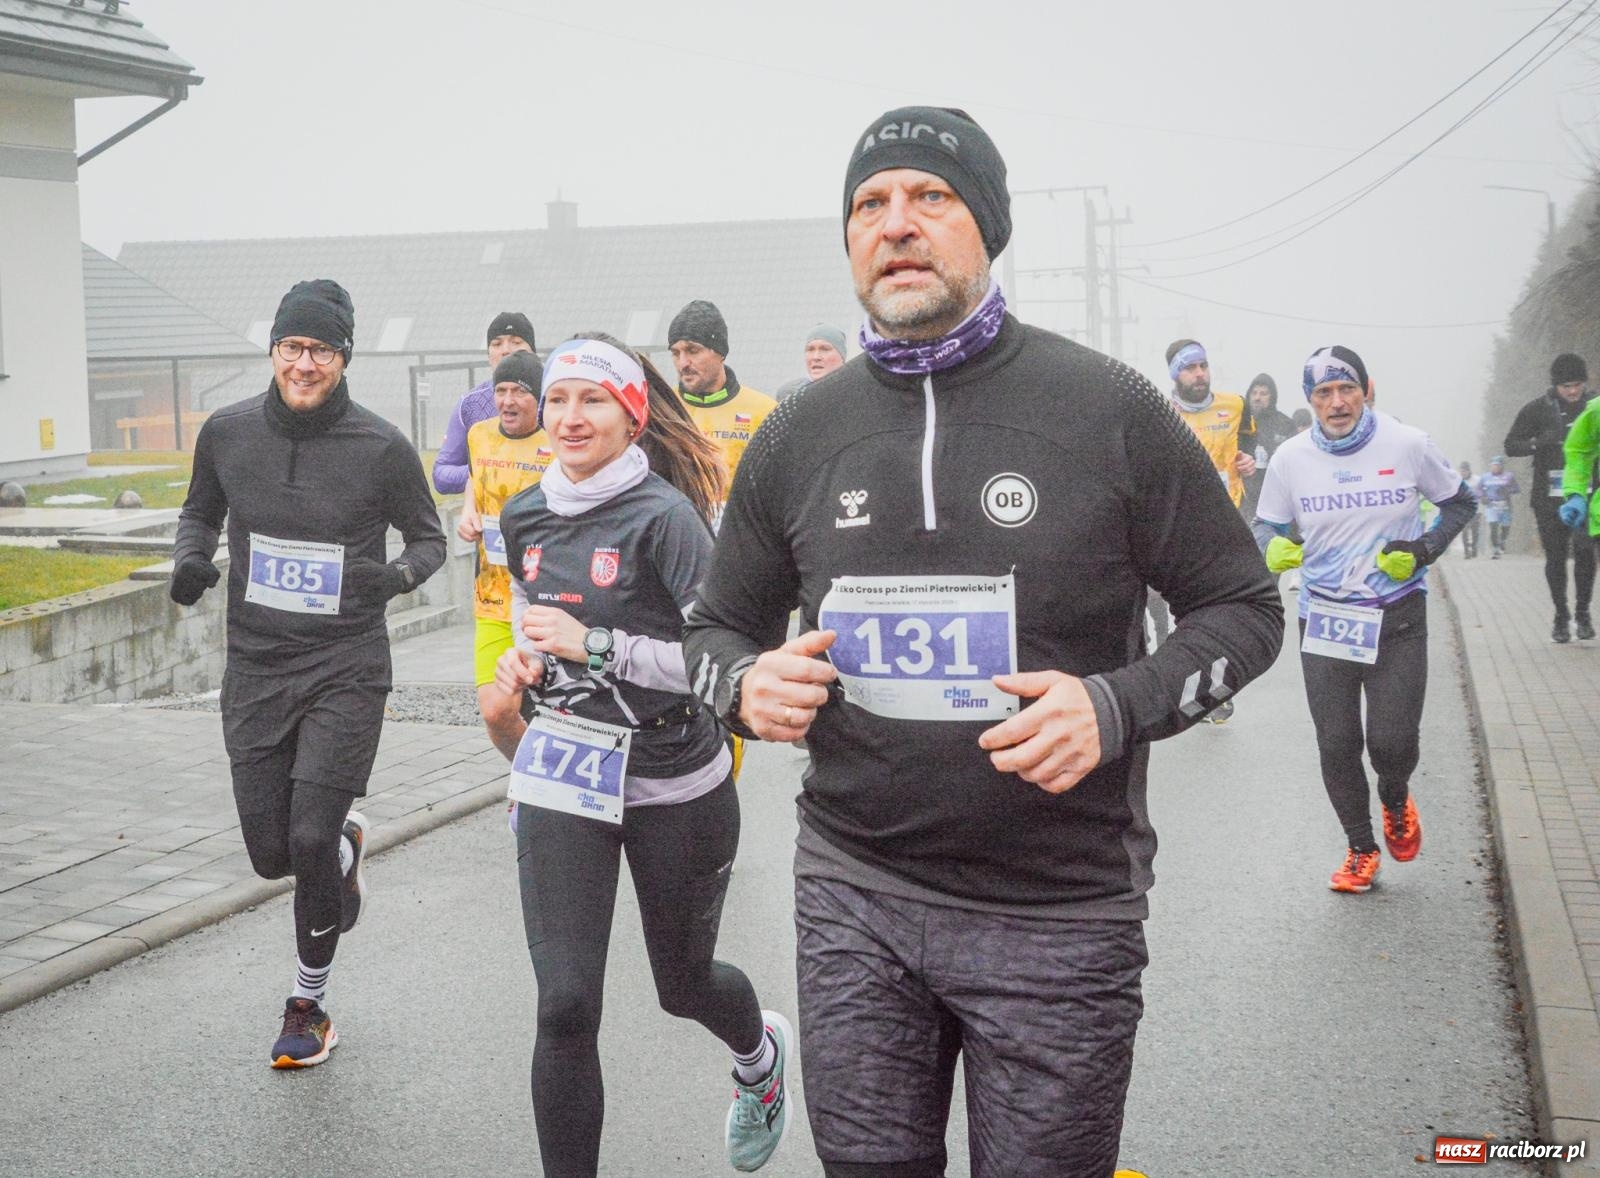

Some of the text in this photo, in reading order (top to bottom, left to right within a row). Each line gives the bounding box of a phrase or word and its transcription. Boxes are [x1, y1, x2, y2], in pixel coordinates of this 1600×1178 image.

[579, 360, 624, 384] MARATHON
[581, 354, 612, 367] SILESIA
[995, 492, 1024, 507] OB
[1300, 488, 1406, 512] RUNNERS
[265, 558, 323, 592] 185
[886, 587, 897, 596] po
[900, 584, 928, 593] Ziemi
[930, 583, 996, 594] Pietrowickiej
[1320, 616, 1365, 645] 194
[854, 617, 978, 675] 131
[527, 735, 602, 789] 174
